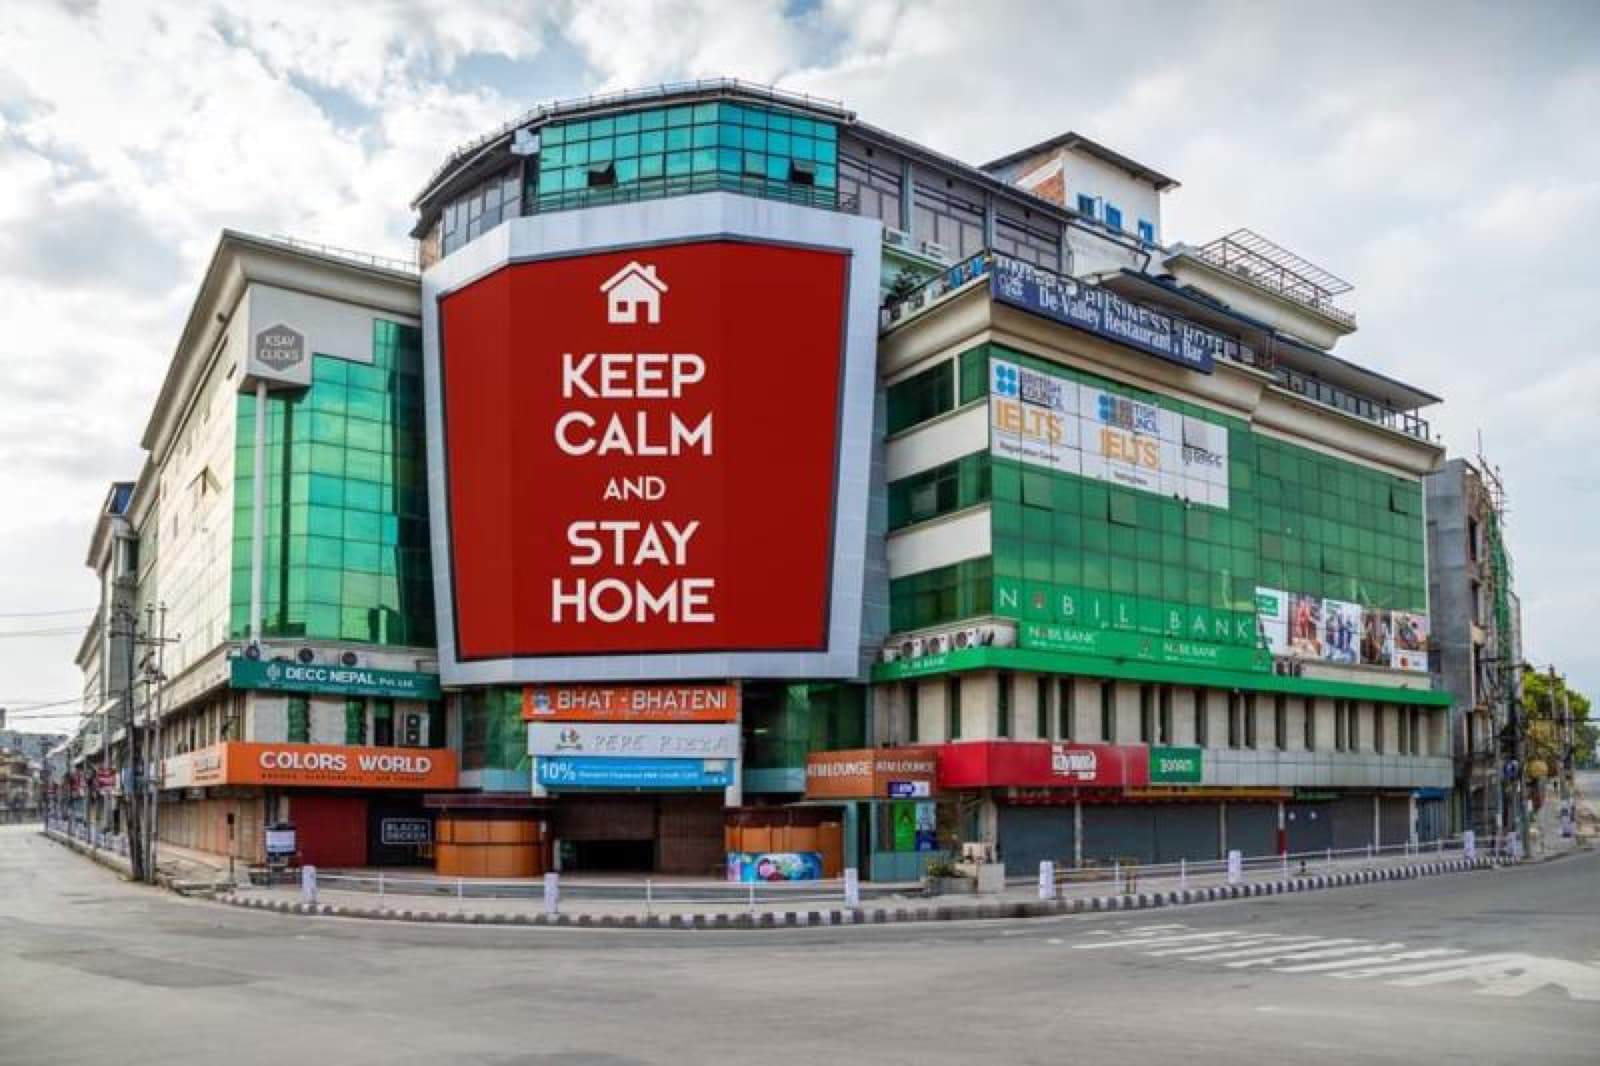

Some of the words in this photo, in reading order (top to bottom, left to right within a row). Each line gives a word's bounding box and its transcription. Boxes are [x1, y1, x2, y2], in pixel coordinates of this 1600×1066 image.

[562, 353, 706, 398] KEEP
[555, 411, 713, 456] CALM
[997, 399, 1063, 448] IELTS
[1101, 428, 1158, 471] IELTS
[603, 475, 667, 501] AND
[567, 520, 700, 566] STAY
[552, 577, 716, 623] HOME
[1063, 630, 1095, 644] BANK
[1169, 610, 1252, 639] BANK
[285, 667, 327, 681] DECC
[329, 669, 377, 685] NEPAL
[557, 689, 614, 709] BHAT
[631, 689, 727, 710] BHATENI
[259, 751, 347, 771] COLORS
[358, 755, 432, 773] WORLD
[540, 761, 576, 782] 10%
[828, 762, 871, 776] LOUNGE
